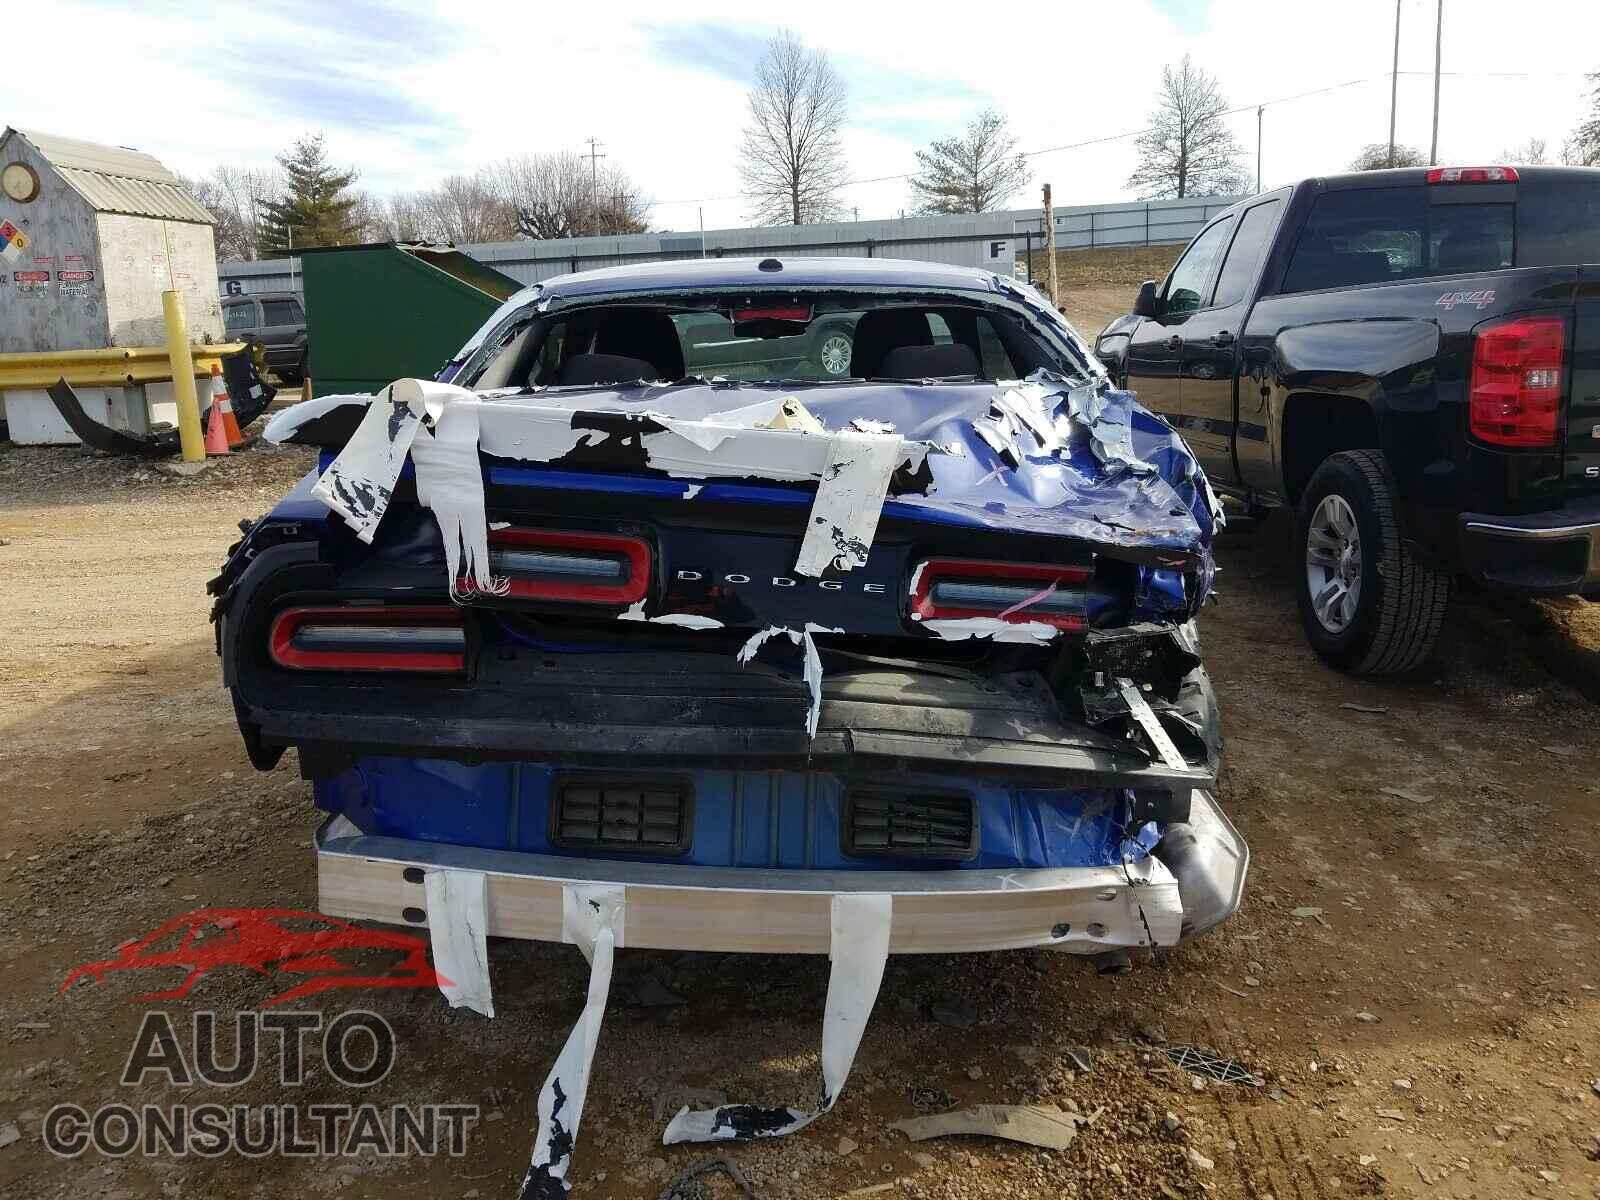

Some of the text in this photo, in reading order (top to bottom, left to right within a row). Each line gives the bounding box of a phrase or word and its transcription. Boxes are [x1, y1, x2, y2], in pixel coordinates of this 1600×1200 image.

[17, 238, 23, 248] 0
[990, 241, 1006, 258] F
[226, 280, 242, 296] G
[677, 569, 886, 594] DODGE
